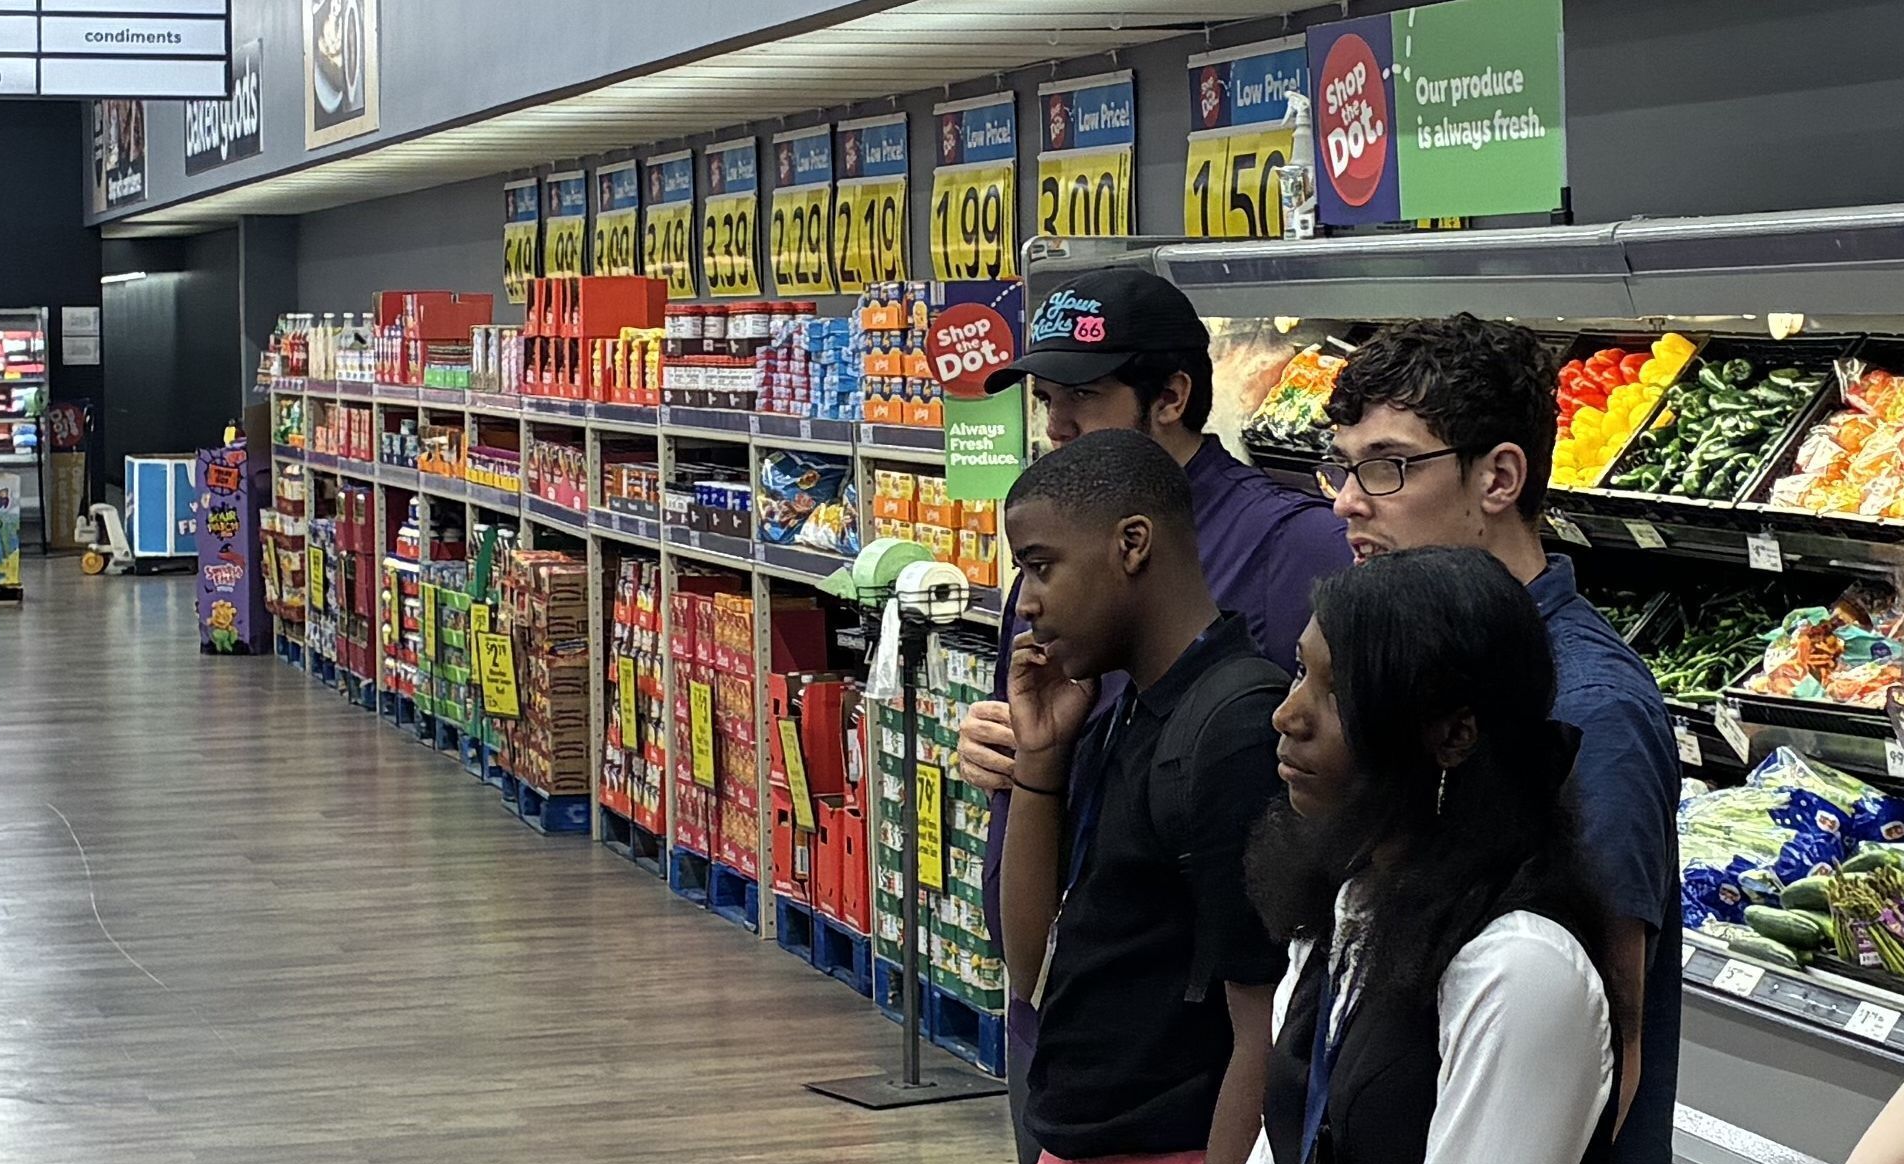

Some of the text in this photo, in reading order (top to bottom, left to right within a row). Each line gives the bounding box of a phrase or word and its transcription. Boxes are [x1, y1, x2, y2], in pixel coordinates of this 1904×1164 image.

[84, 29, 182, 45] condiments
[1236, 69, 1301, 107] Low Price!
[1326, 61, 1367, 115] Shop
[1415, 66, 1524, 107] Our produce
[1078, 100, 1130, 133] Low Price!
[1341, 99, 1360, 126] the
[967, 120, 1012, 149] Low Price!
[1327, 99, 1384, 179] Dot.
[1417, 106, 1546, 151] is always fresh.
[774, 203, 823, 287] 2.29
[838, 196, 896, 283] 2.19
[937, 184, 1001, 280] 1.99
[1047, 289, 1102, 318] Your
[936, 318, 991, 348] Shop
[955, 338, 981, 353] the
[1077, 322, 1102, 338] 66
[935, 339, 1009, 382] Dot.
[949, 422, 1006, 438] Always
[950, 437, 994, 451] Fresh
[950, 452, 1019, 466] Produce.
